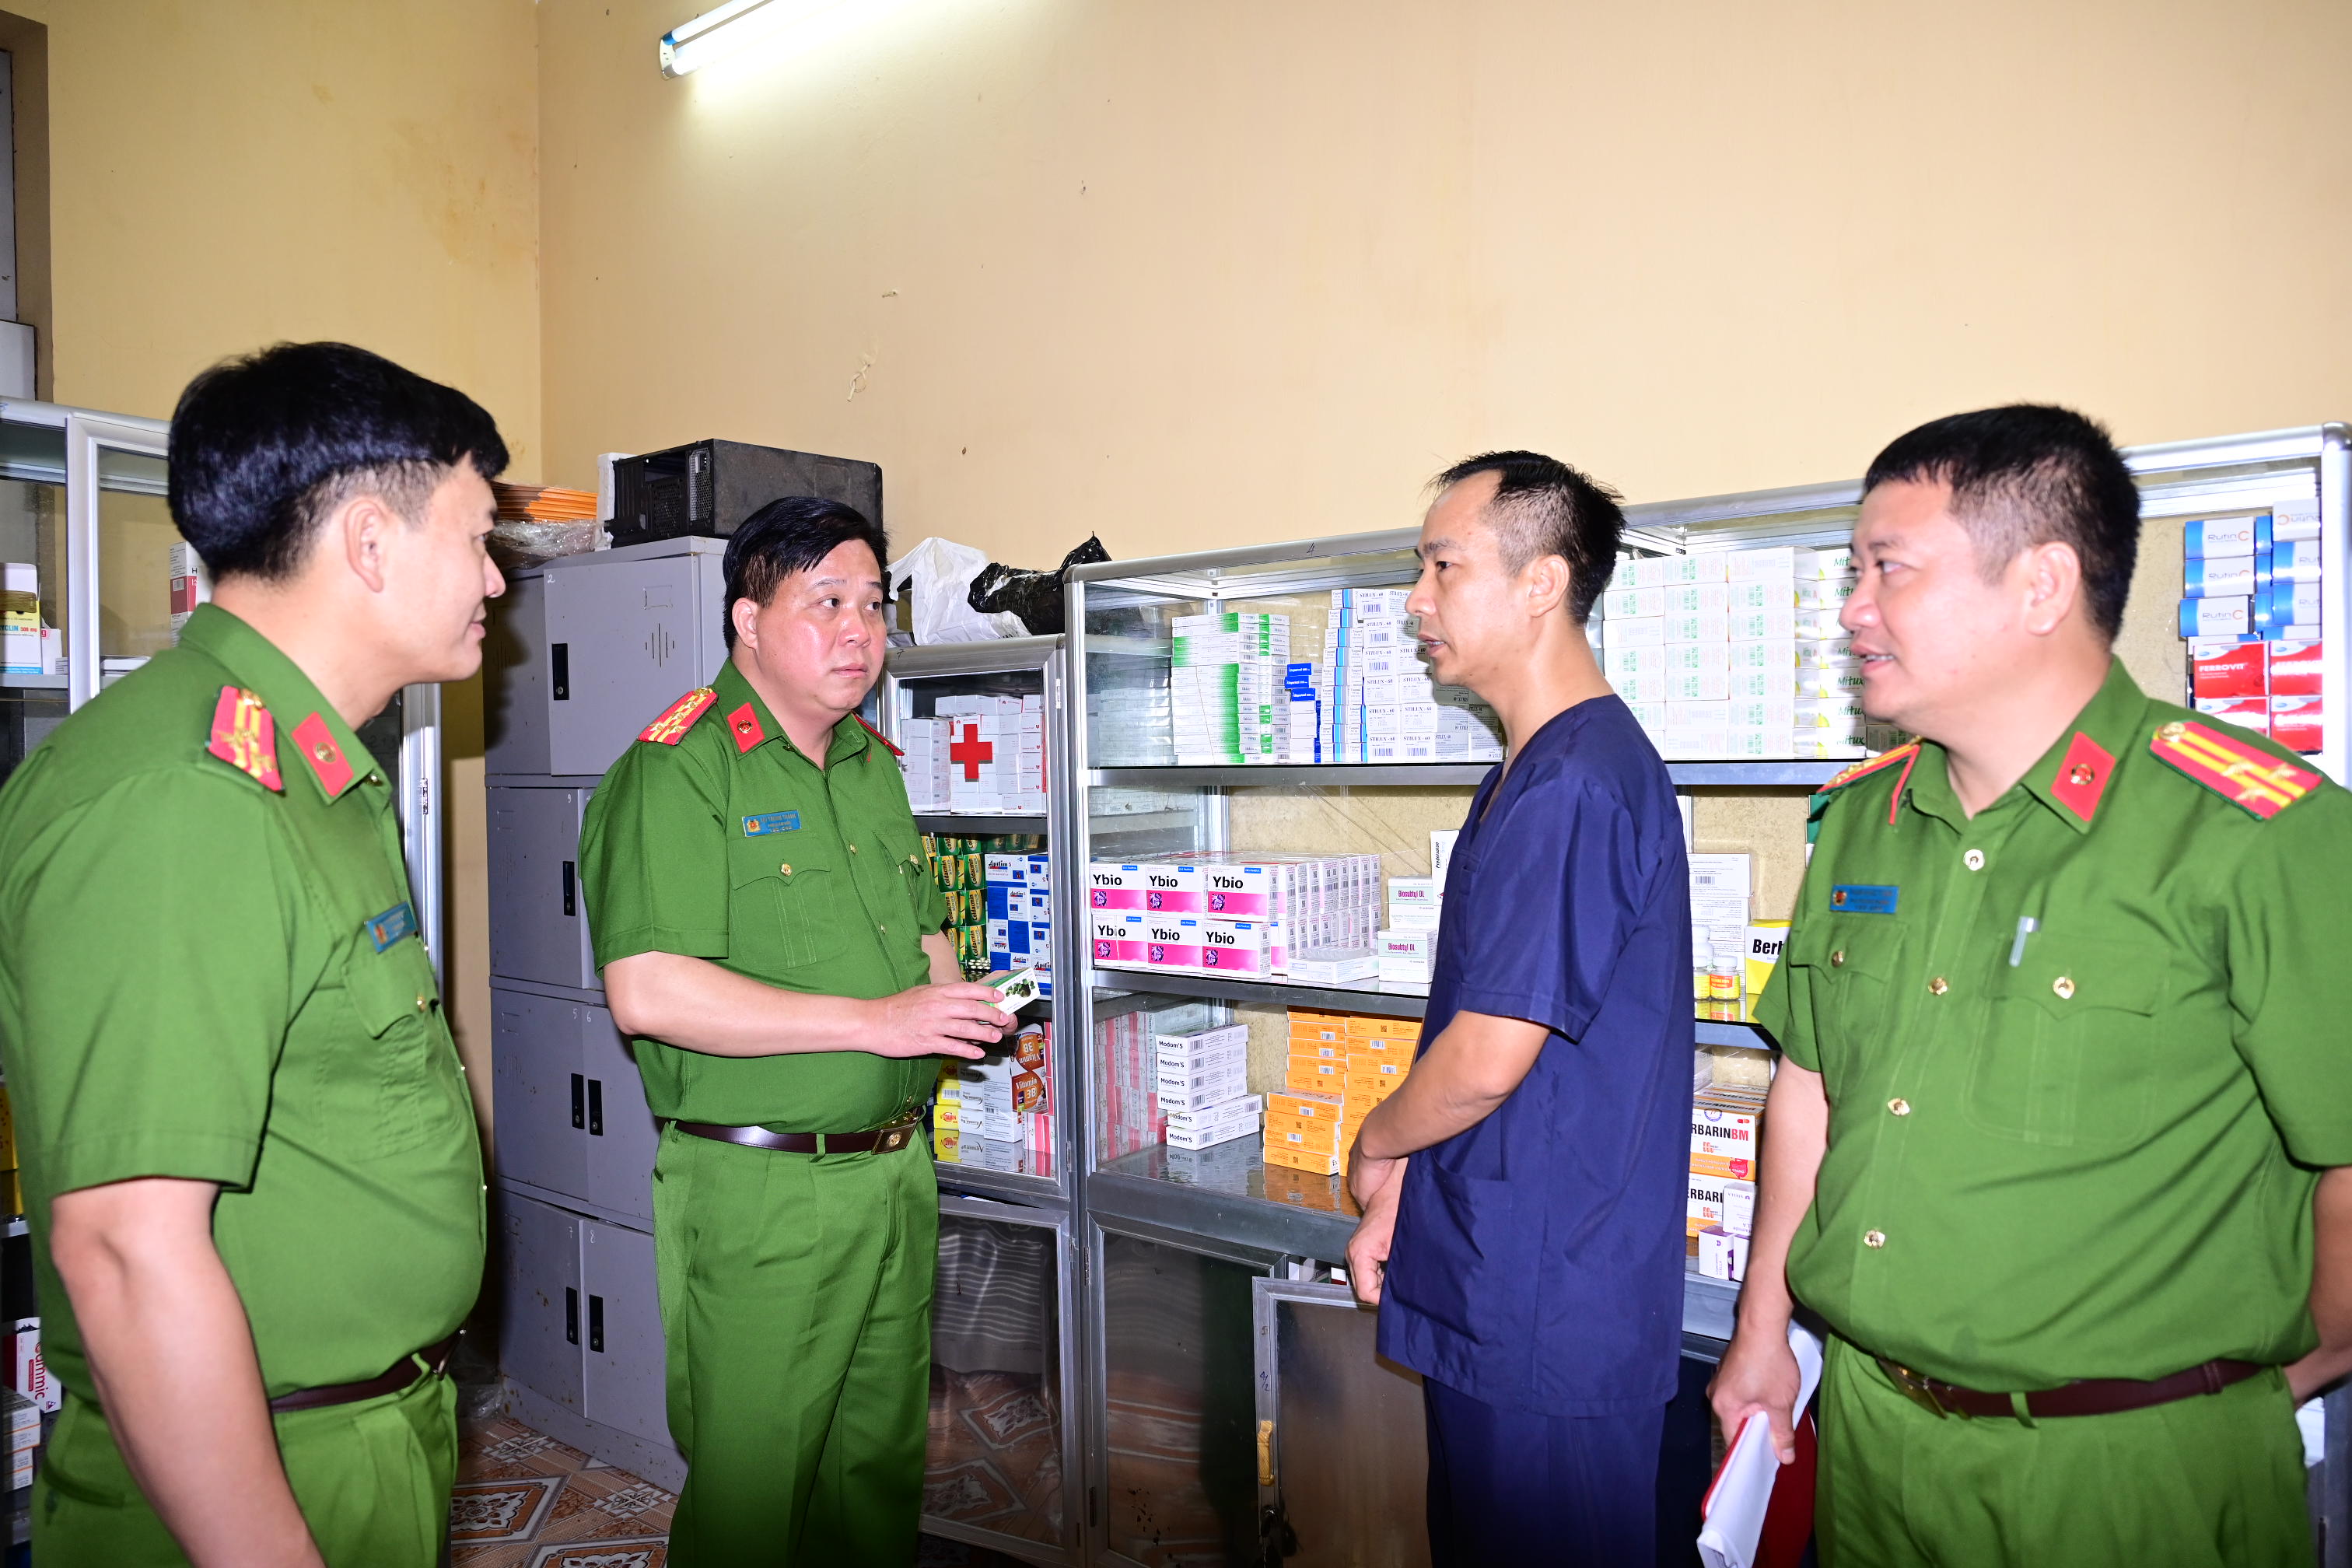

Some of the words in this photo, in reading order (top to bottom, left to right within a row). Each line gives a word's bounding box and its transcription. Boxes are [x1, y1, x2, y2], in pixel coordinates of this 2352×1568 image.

[548, 573, 555, 583] 2
[2199, 663, 2245, 672] FERROVIT
[1093, 873, 1122, 886] Ybio
[1149, 875, 1178, 887] Ybio
[1213, 876, 1244, 888] Ybio
[1398, 890, 1419, 899] Biosubtyl
[1097, 925, 1126, 937] Ybio
[1151, 928, 1181, 941] Ybio
[1206, 931, 1235, 944] Ybio
[1388, 943, 1409, 952] Biosubtyl
[586, 1011, 591, 1023] 6
[1159, 1041, 1183, 1049] Modom'S
[1019, 1052, 1041, 1064] Vitamin
[1160, 1059, 1185, 1068] Modom'S
[1015, 1077, 1038, 1090] Vitamin
[1160, 1077, 1185, 1087] Modom'S
[1027, 1087, 1037, 1099] 3B
[1160, 1097, 1185, 1106] Modom'S
[1169, 1133, 1192, 1143] Modom'S
